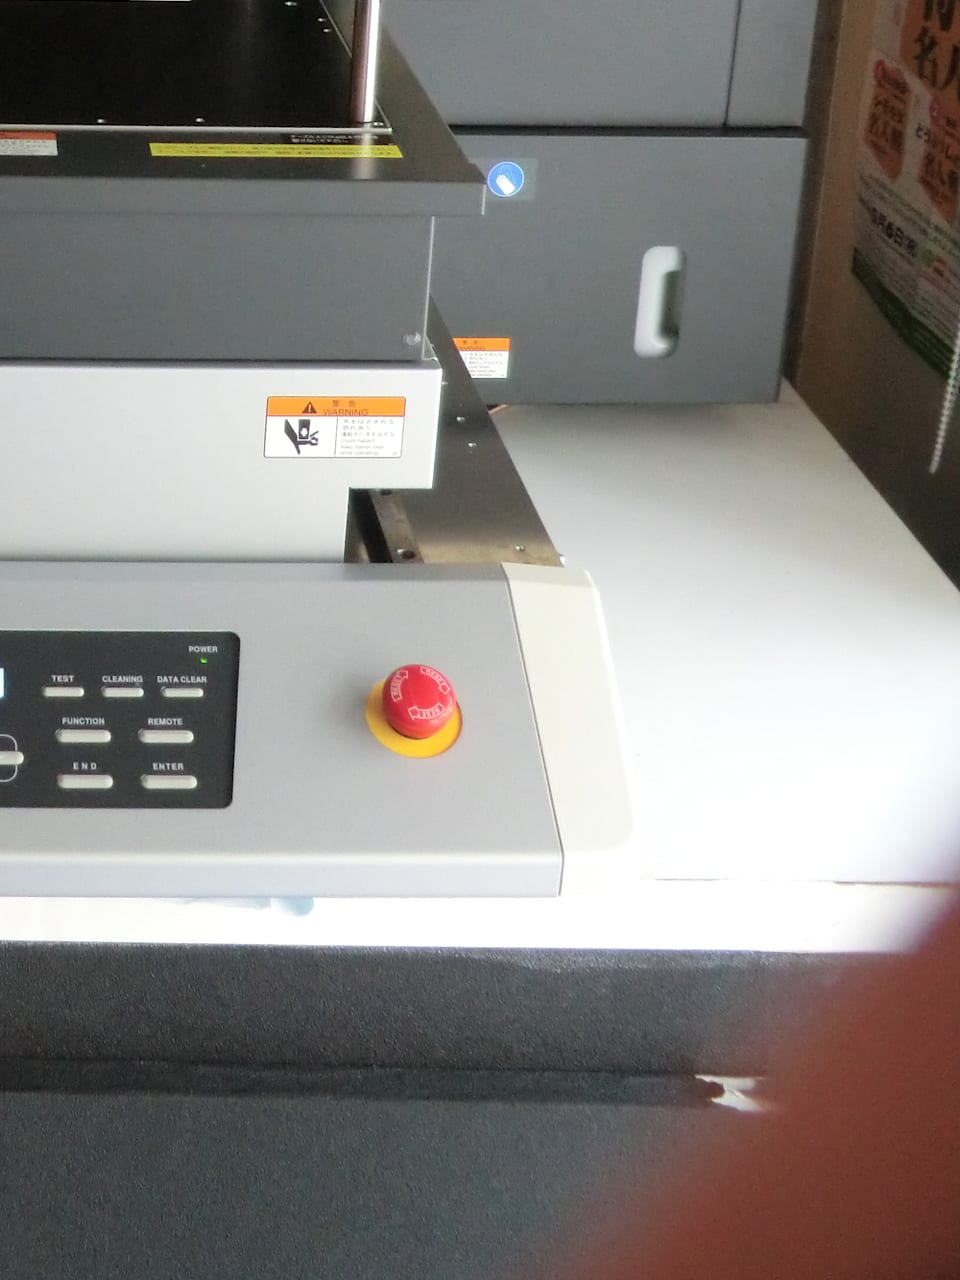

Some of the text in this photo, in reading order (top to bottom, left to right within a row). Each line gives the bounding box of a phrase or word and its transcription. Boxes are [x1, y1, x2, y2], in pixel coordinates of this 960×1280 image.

[323, 408, 368, 416] WARNING
[102, 675, 144, 683] CLEANING
[61, 717, 105, 725] FUNCTION
